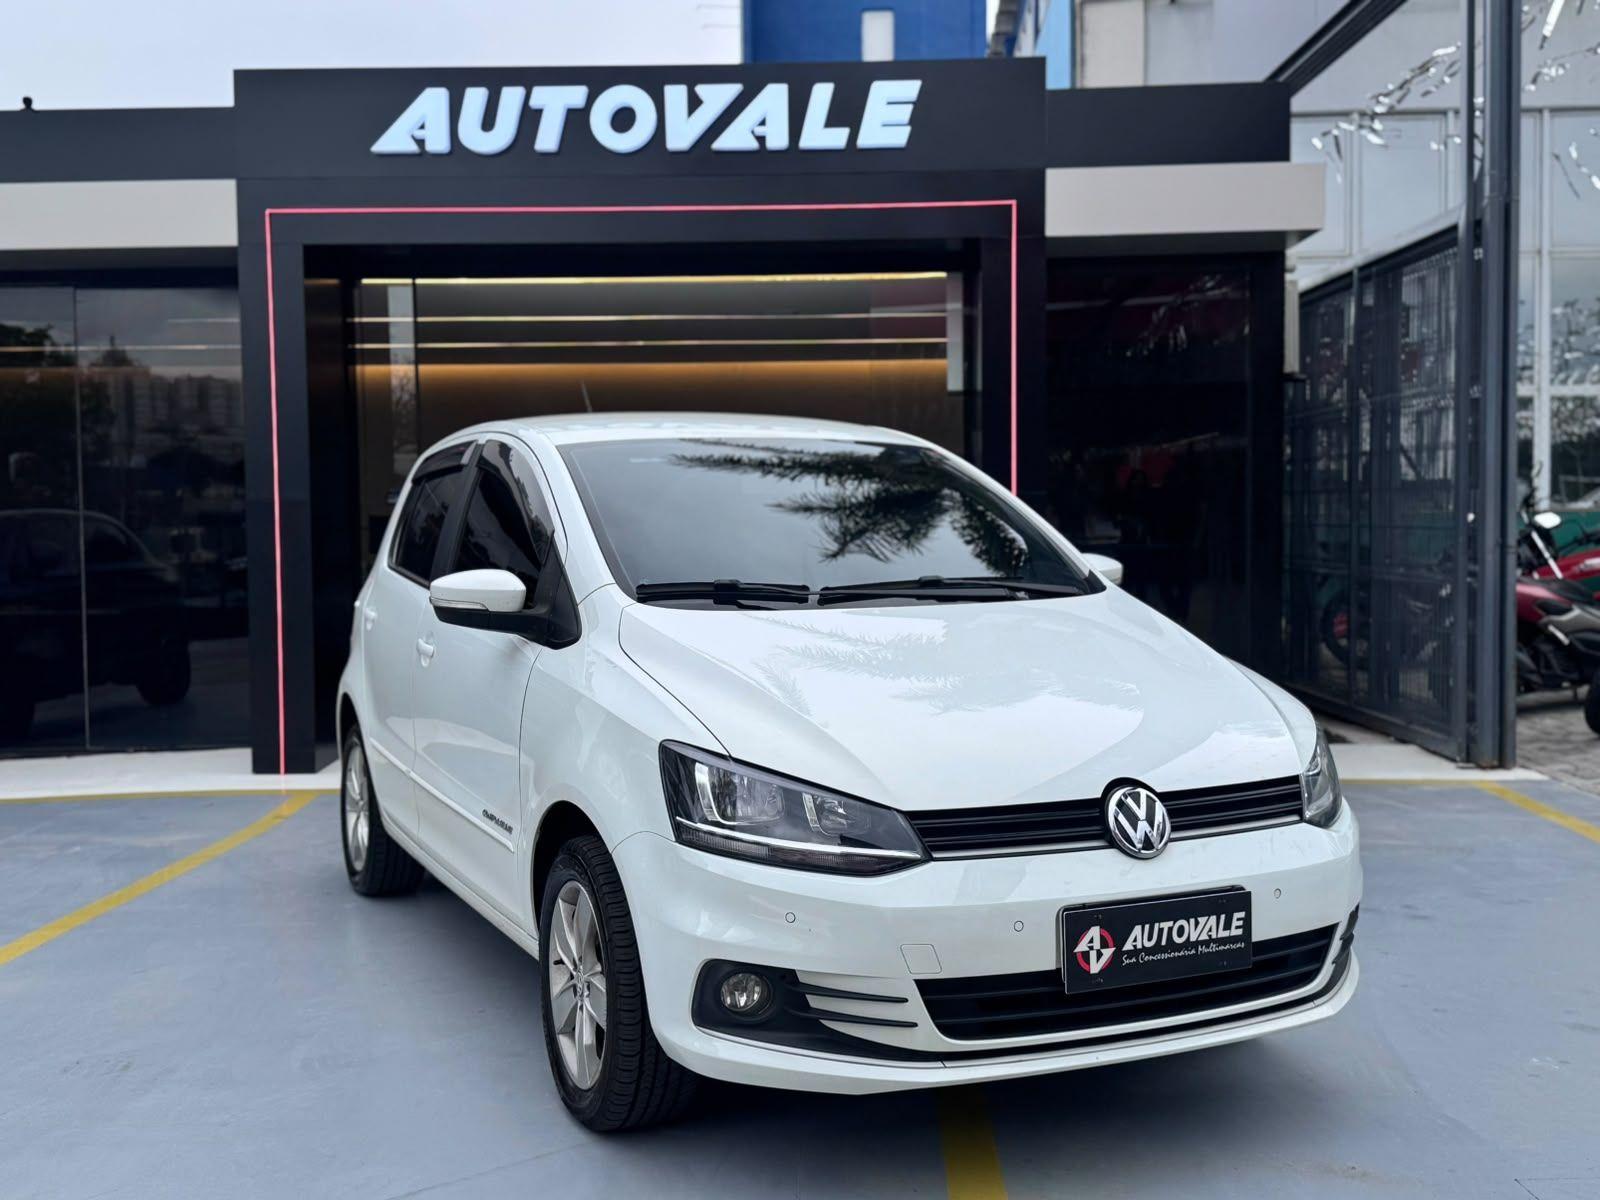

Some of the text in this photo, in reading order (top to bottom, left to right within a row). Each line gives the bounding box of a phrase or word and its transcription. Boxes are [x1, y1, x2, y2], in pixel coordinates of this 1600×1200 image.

[370, 79, 922, 154] AUTOVALE
[1110, 787, 1168, 853] VW
[1121, 911, 1246, 951] AUTOVALE
[1122, 954, 1137, 966] Sua
[1197, 942, 1245, 955] Multimarcas
